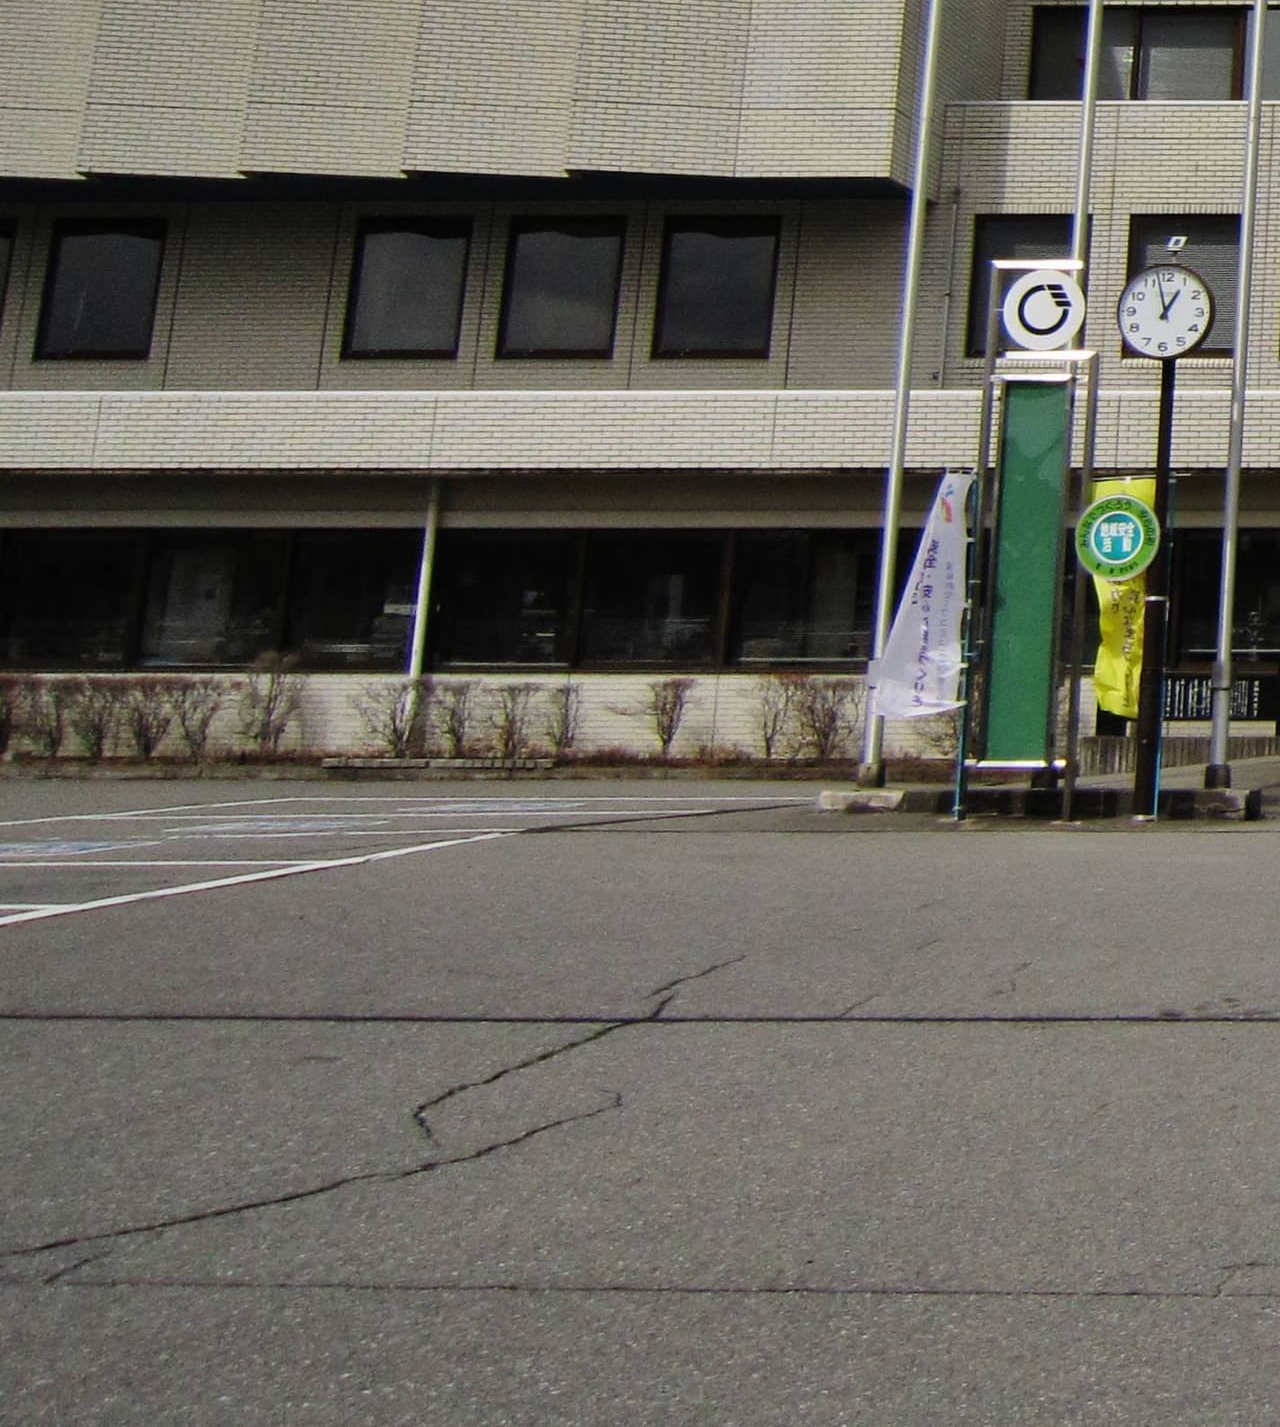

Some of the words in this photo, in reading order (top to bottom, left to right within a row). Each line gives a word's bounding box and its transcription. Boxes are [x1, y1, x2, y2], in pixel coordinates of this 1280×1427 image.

[1162, 272, 1174, 282] 12
[1183, 277, 1186, 286] 1
[1145, 279, 1155, 288] 11
[1132, 292, 1145, 301] 10
[1191, 290, 1200, 300] 2
[1126, 307, 1136, 316] 9
[1195, 308, 1204, 317] 3
[1130, 323, 1139, 332] 8
[1187, 324, 1198, 332] 4
[1142, 338, 1152, 346] 7
[1176, 337, 1186, 346] 5
[1158, 342, 1168, 352] 6
